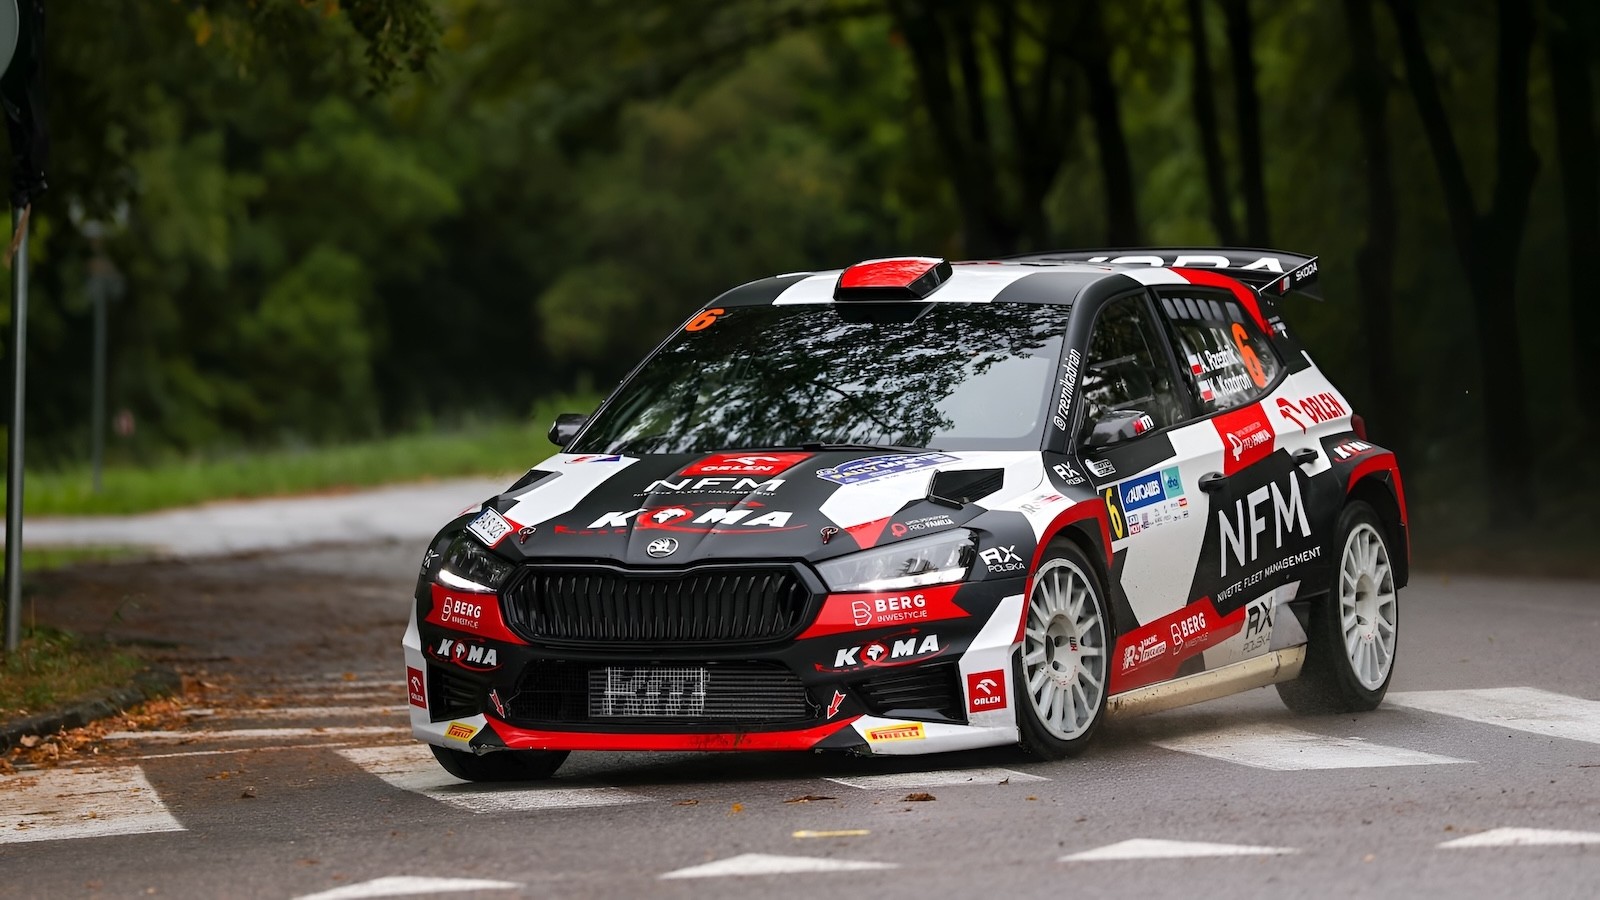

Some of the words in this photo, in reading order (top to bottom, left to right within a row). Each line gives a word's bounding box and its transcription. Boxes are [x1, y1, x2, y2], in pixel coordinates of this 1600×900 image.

[685, 308, 725, 331] 6
[1231, 322, 1266, 389] 6
[1299, 392, 1347, 424] ORLEN
[643, 477, 786, 493] NFM
[1105, 487, 1123, 539] 6
[1218, 470, 1311, 578] NFM
[988, 562, 1026, 573] POLSKA
[1243, 570, 1263, 589] FLEET
[1264, 546, 1321, 579] MANAGEMENT
[453, 600, 482, 619] BERG
[875, 594, 926, 612] BERG
[877, 610, 928, 623] INWESTYCJE
[1180, 611, 1206, 638] BERG
[973, 695, 1001, 706] ORLEN
[870, 726, 920, 740] PIRELLI
